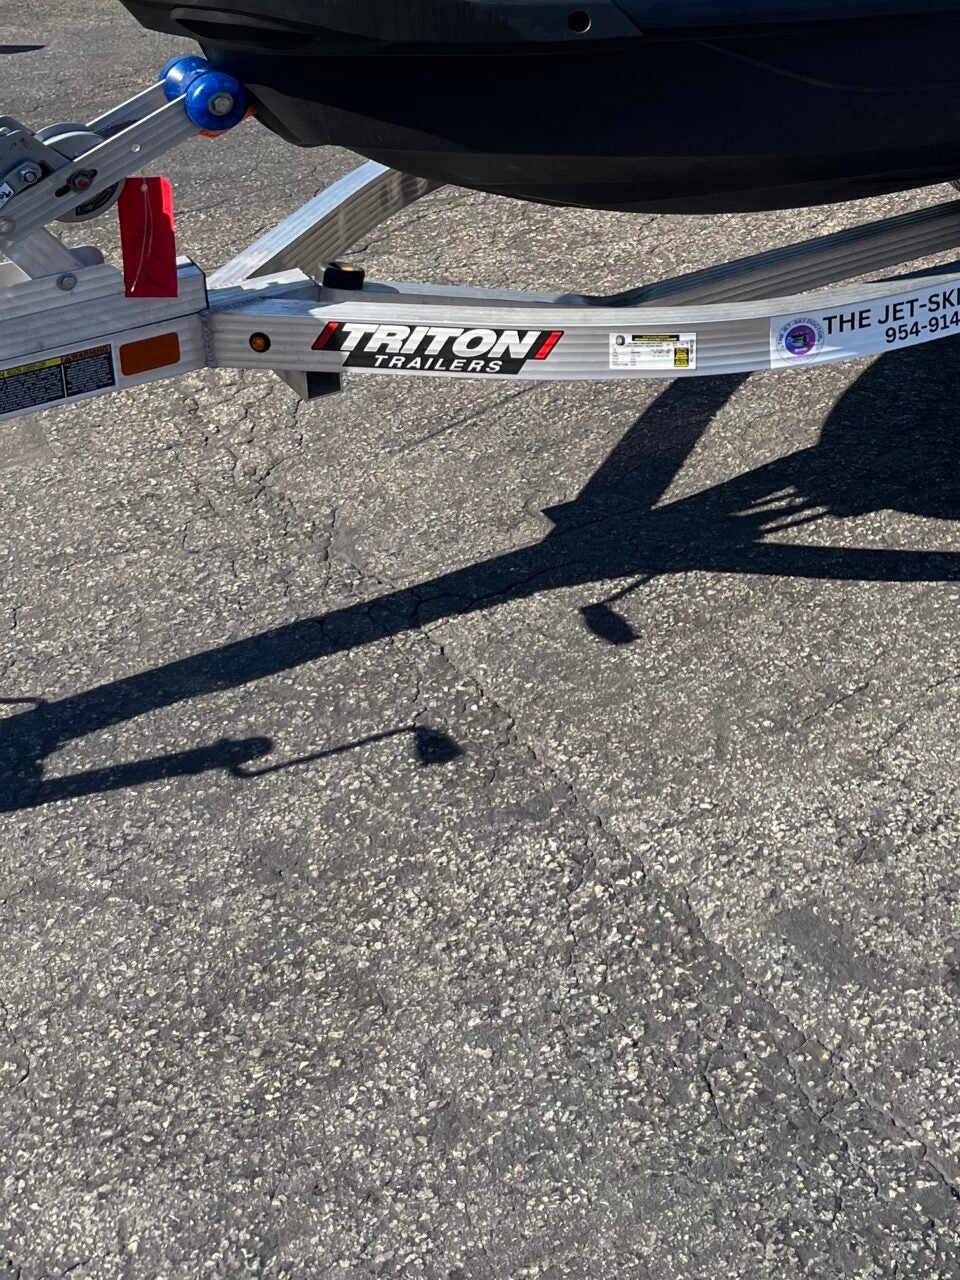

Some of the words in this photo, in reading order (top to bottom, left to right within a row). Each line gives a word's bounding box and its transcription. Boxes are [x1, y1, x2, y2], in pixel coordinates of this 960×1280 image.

[823, 309, 872, 335] THE
[877, 288, 960, 325] JET-SKI
[339, 323, 542, 359] TRITON
[374, 354, 503, 373] TRAILERS
